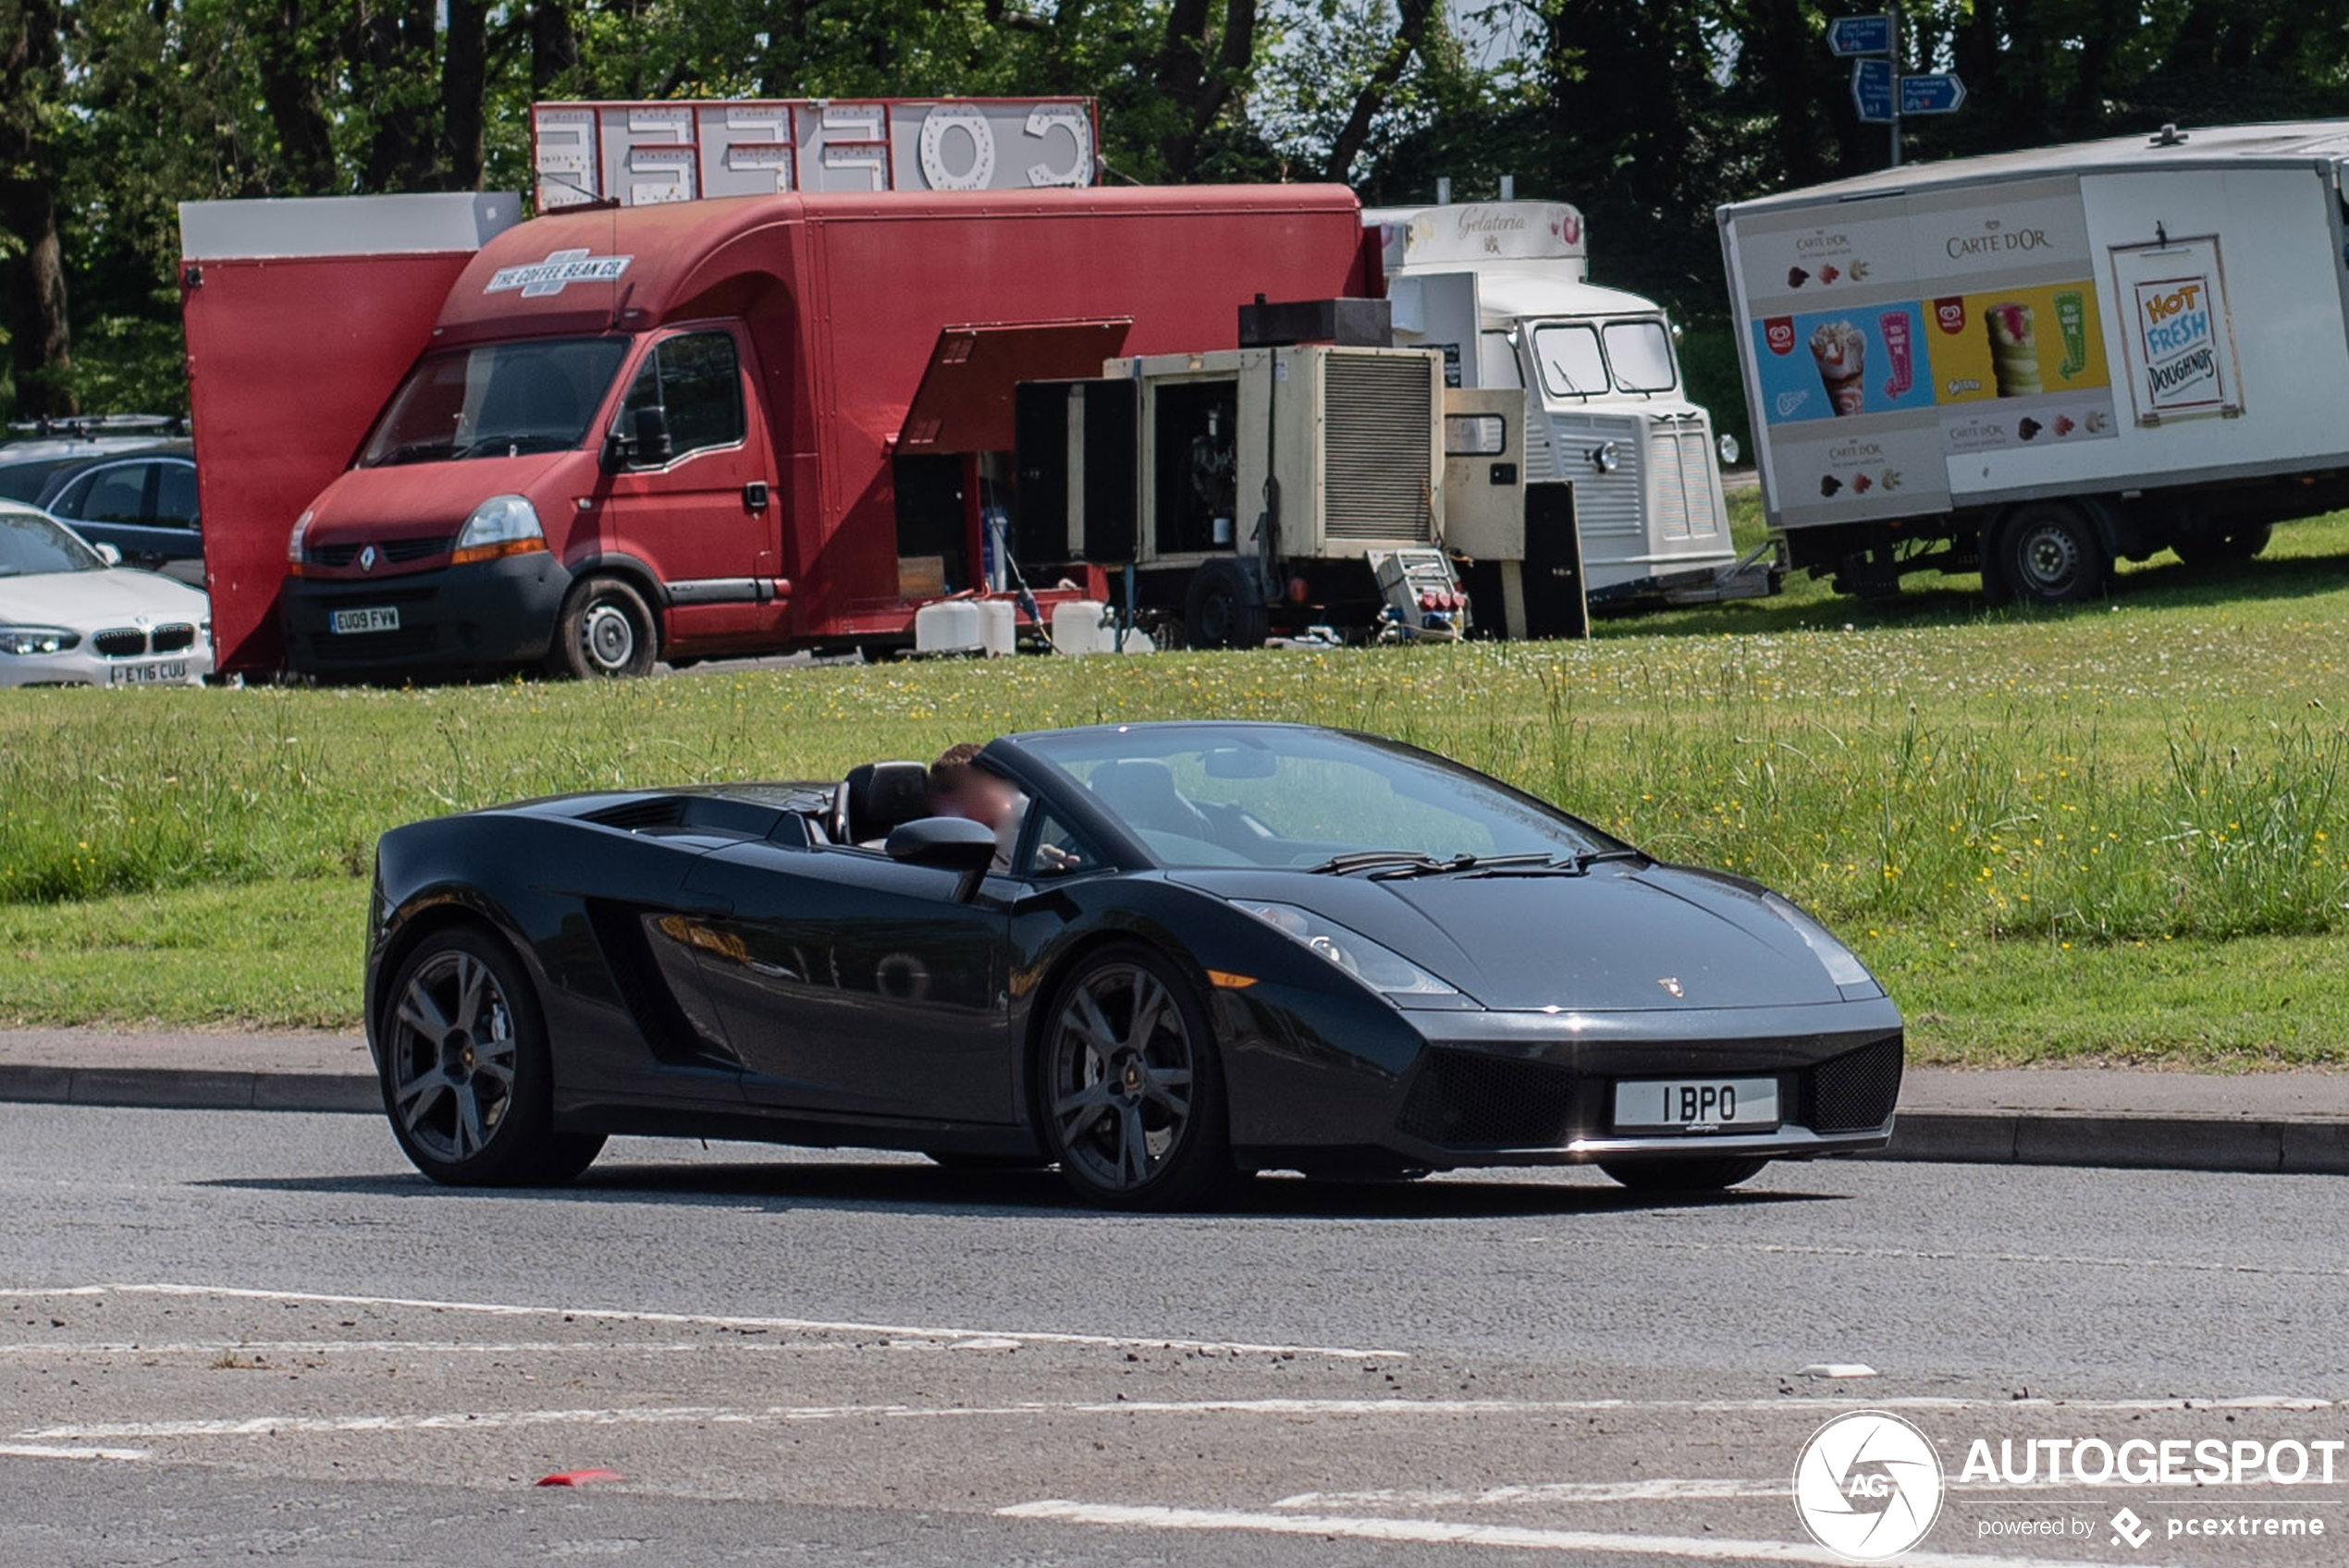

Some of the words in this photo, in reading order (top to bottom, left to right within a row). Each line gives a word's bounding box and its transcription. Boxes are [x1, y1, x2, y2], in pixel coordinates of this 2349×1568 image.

[1457, 205, 1525, 240] Gelateria
[1946, 237, 2000, 260] CARTE
[2004, 228, 2054, 251] D'OR
[516, 264, 563, 284] COFFEE
[563, 261, 600, 278] BEAN
[2146, 285, 2200, 324] HOT
[2146, 311, 2207, 354] FRESH
[338, 611, 368, 630] EU09
[371, 609, 396, 628] FVW
[126, 666, 156, 683] EY16
[160, 662, 186, 680] CUU
[1680, 1085, 1736, 1121] BPO
